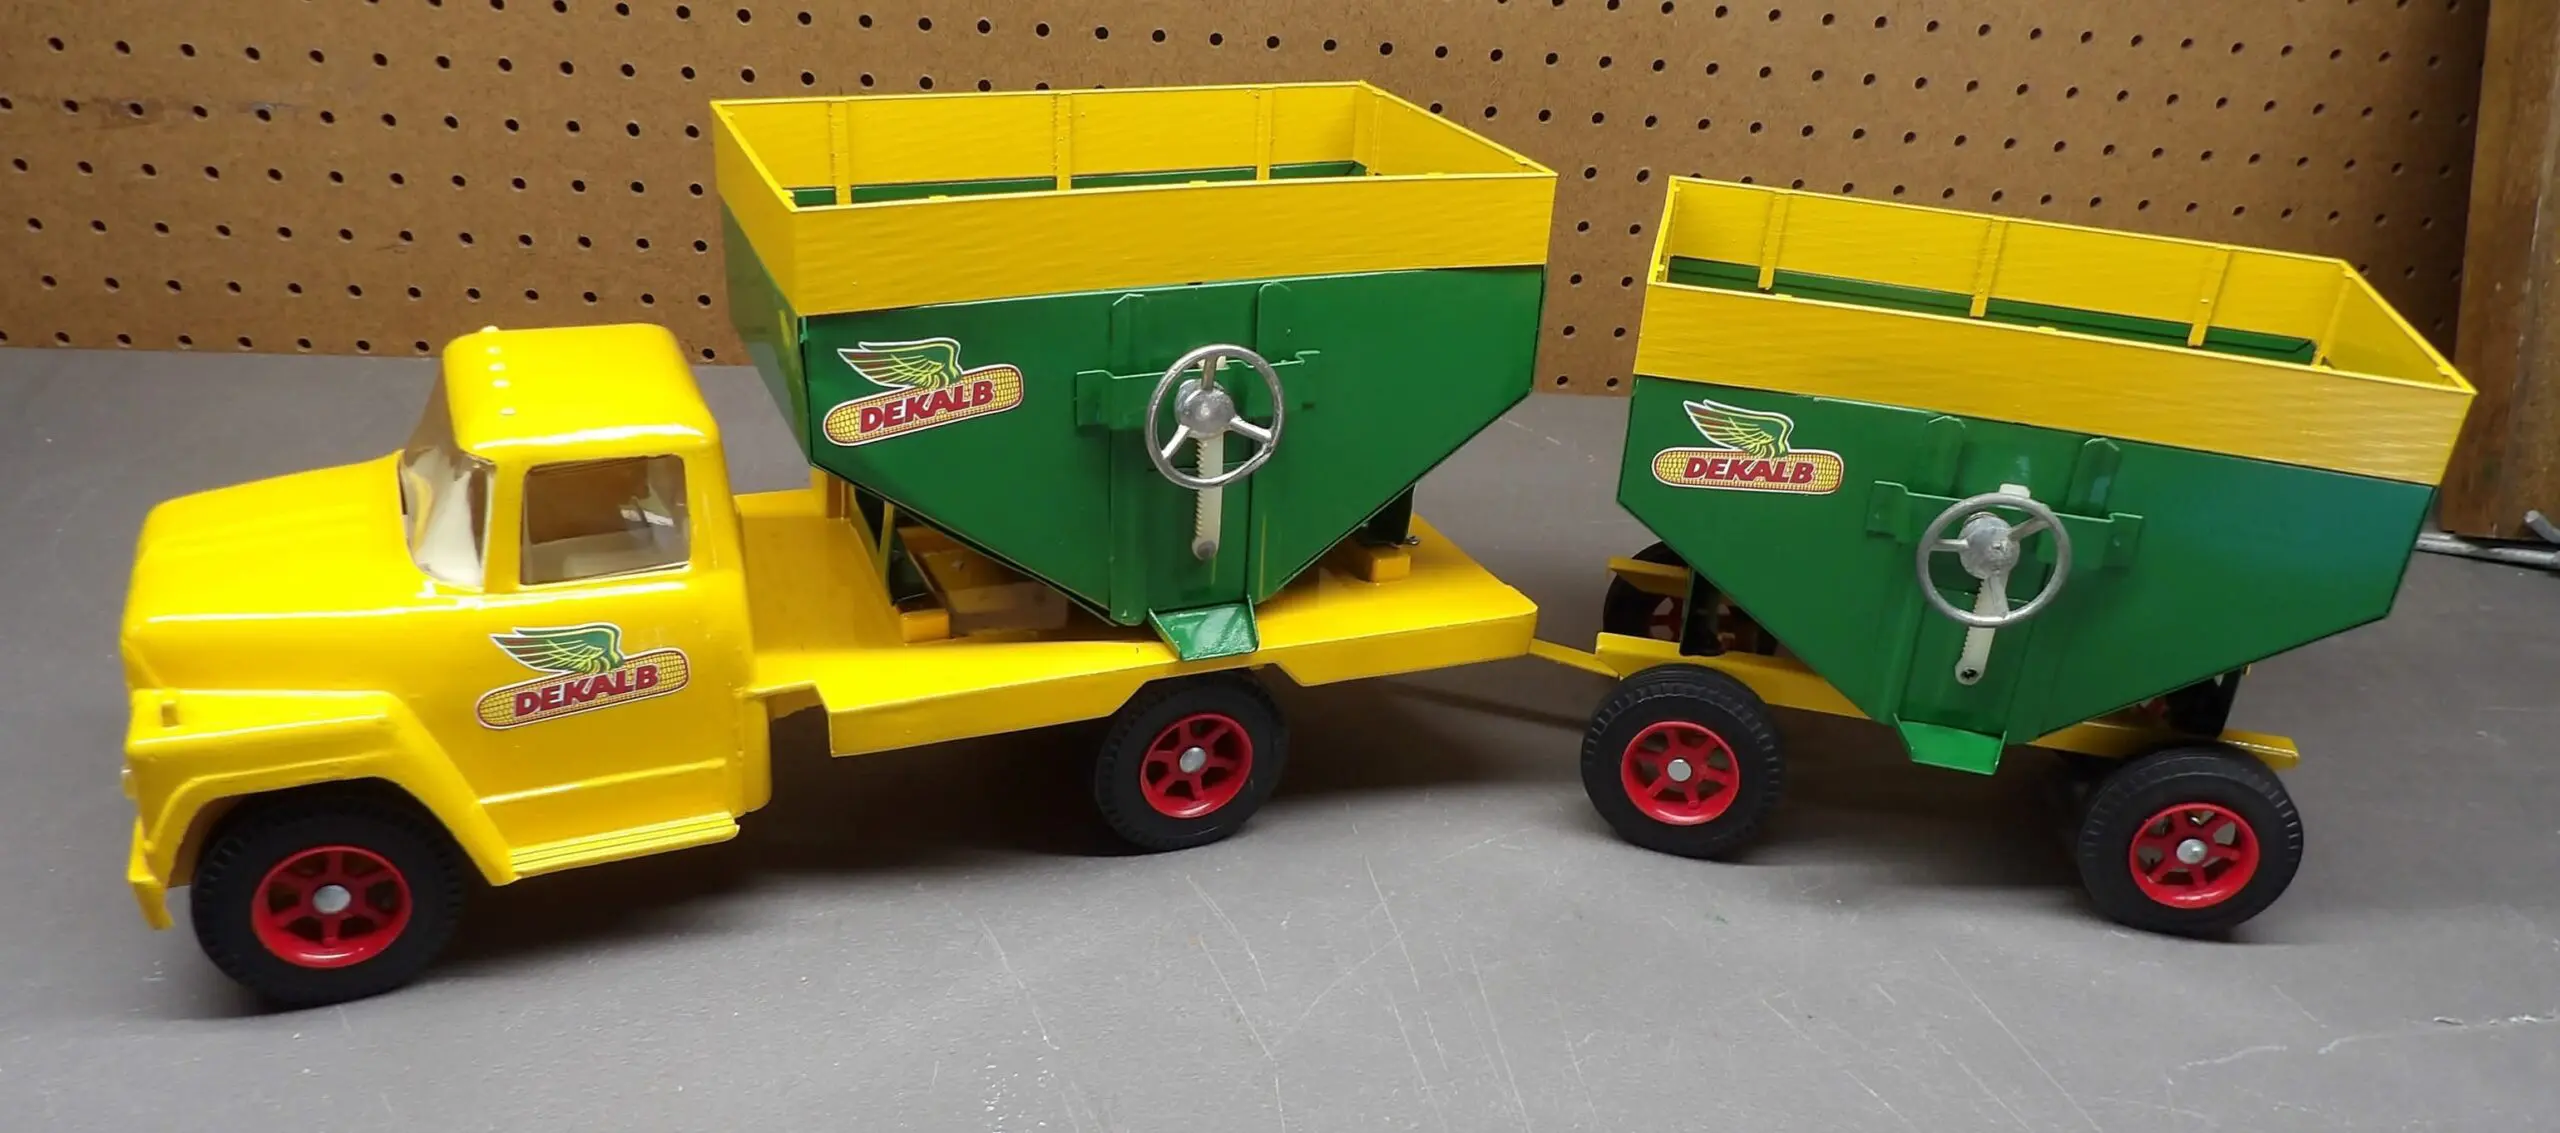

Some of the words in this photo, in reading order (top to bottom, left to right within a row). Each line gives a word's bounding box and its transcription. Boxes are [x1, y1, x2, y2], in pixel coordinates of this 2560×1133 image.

[859, 379, 995, 434] DEKALB
[1682, 456, 1815, 485] DEKALB
[513, 663, 660, 718] DEKALB
